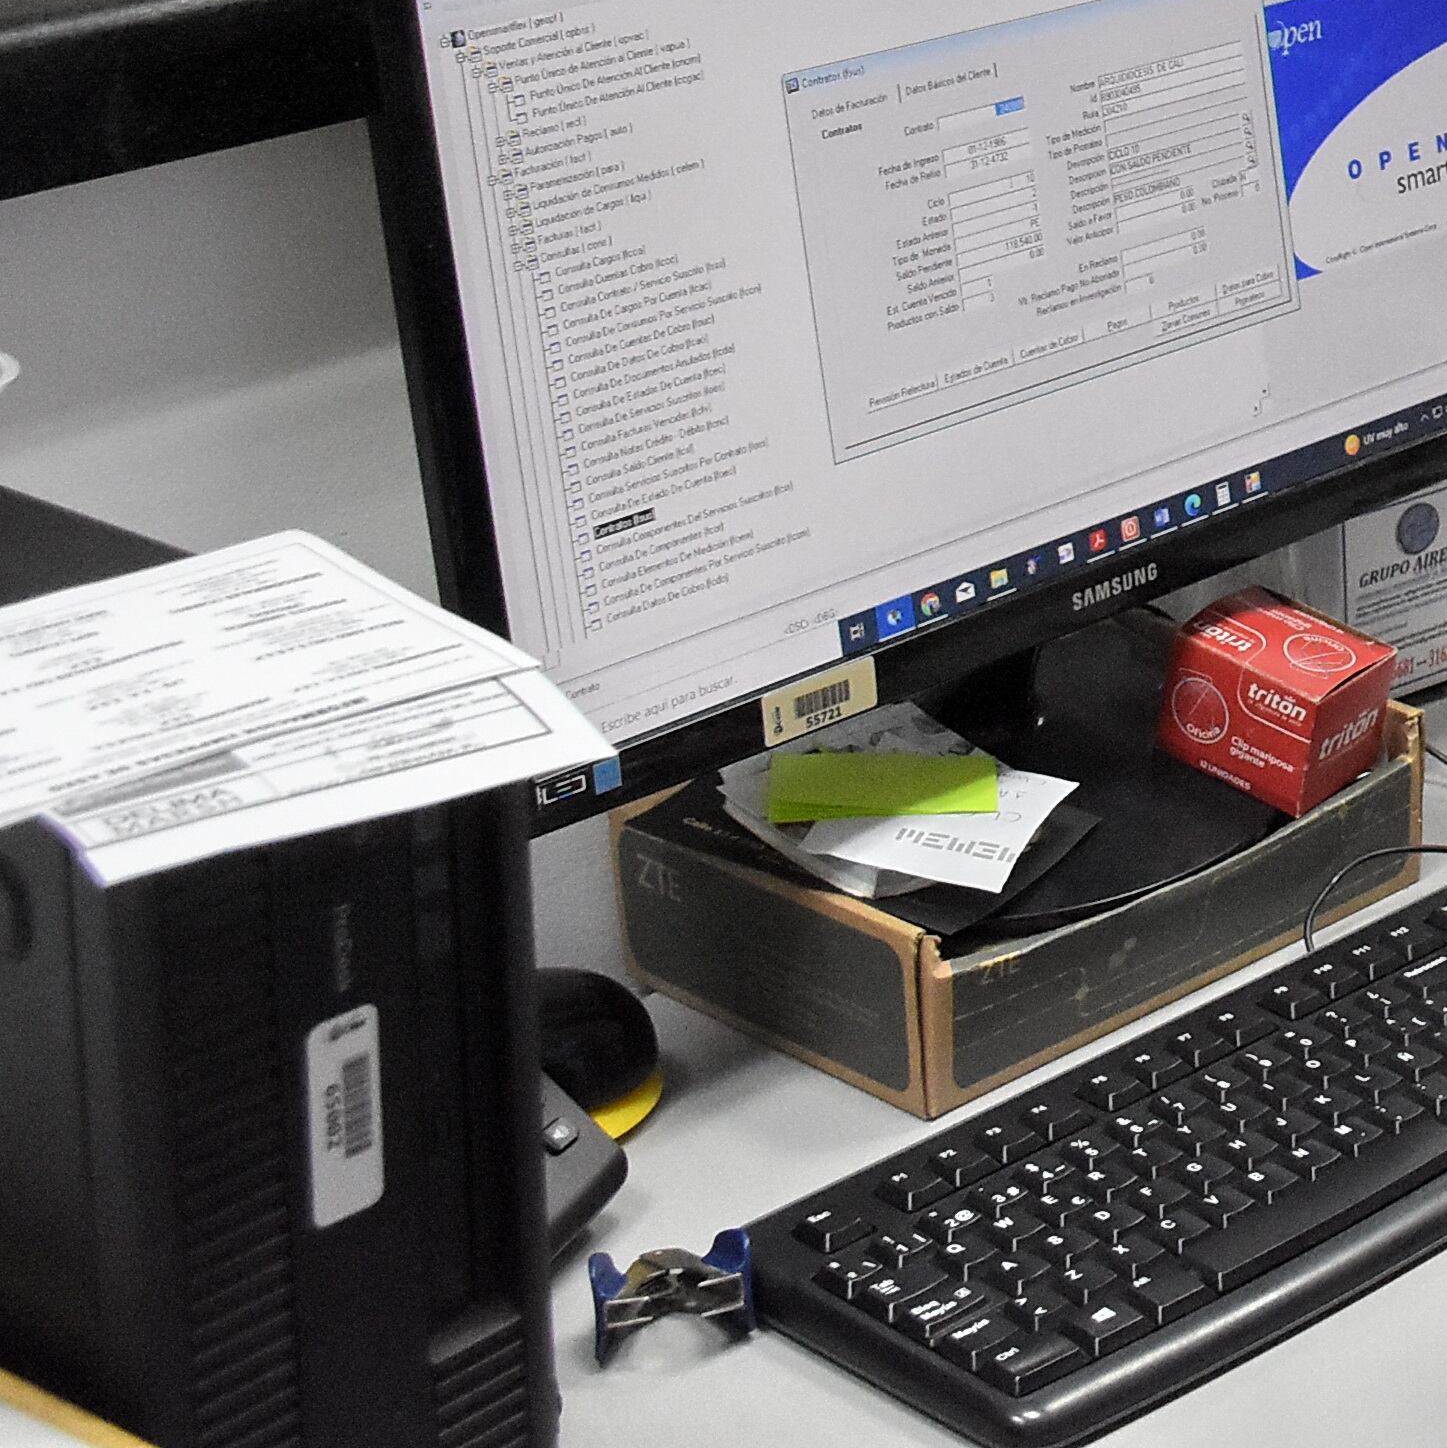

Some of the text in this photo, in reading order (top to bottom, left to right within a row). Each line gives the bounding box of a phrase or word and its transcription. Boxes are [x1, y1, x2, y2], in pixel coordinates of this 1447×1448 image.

[529, 85, 555, 102] Punto
[581, 76, 595, 90] De
[801, 69, 841, 90] Contratos
[905, 82, 926, 96] Datos
[955, 72, 967, 84] del
[967, 66, 991, 81] Cliente
[1069, 78, 1095, 94] Nombre
[811, 104, 833, 120] Datos
[845, 91, 888, 111] Facturación
[821, 120, 862, 140] Contratos
[904, 120, 934, 137] Contrato
[1046, 133, 1060, 146] Tipo
[878, 162, 899, 178] Fecha
[911, 152, 939, 169] Ingreso
[1128, 154, 1151, 170] SALDO
[1151, 143, 1191, 163] PENDIENTE
[885, 176, 907, 191] Fecha
[927, 196, 945, 210] Ciclo
[917, 256, 952, 275] Pendiente
[887, 312, 923, 333] Productos
[939, 301, 959, 317] Saldo
[1394, 421, 1409, 434] alto
[1360, 560, 1410, 588] GRUPO
[1413, 547, 1447, 573] AIRE
[1071, 563, 1158, 611] SAMSUNG
[601, 710, 642, 734] Escribe
[645, 701, 668, 717] aquí
[805, 706, 842, 728] 55721
[1229, 746, 1265, 768] gigante
[1231, 736, 1295, 773] Clip mariposa
[638, 860, 682, 902] ZTE
